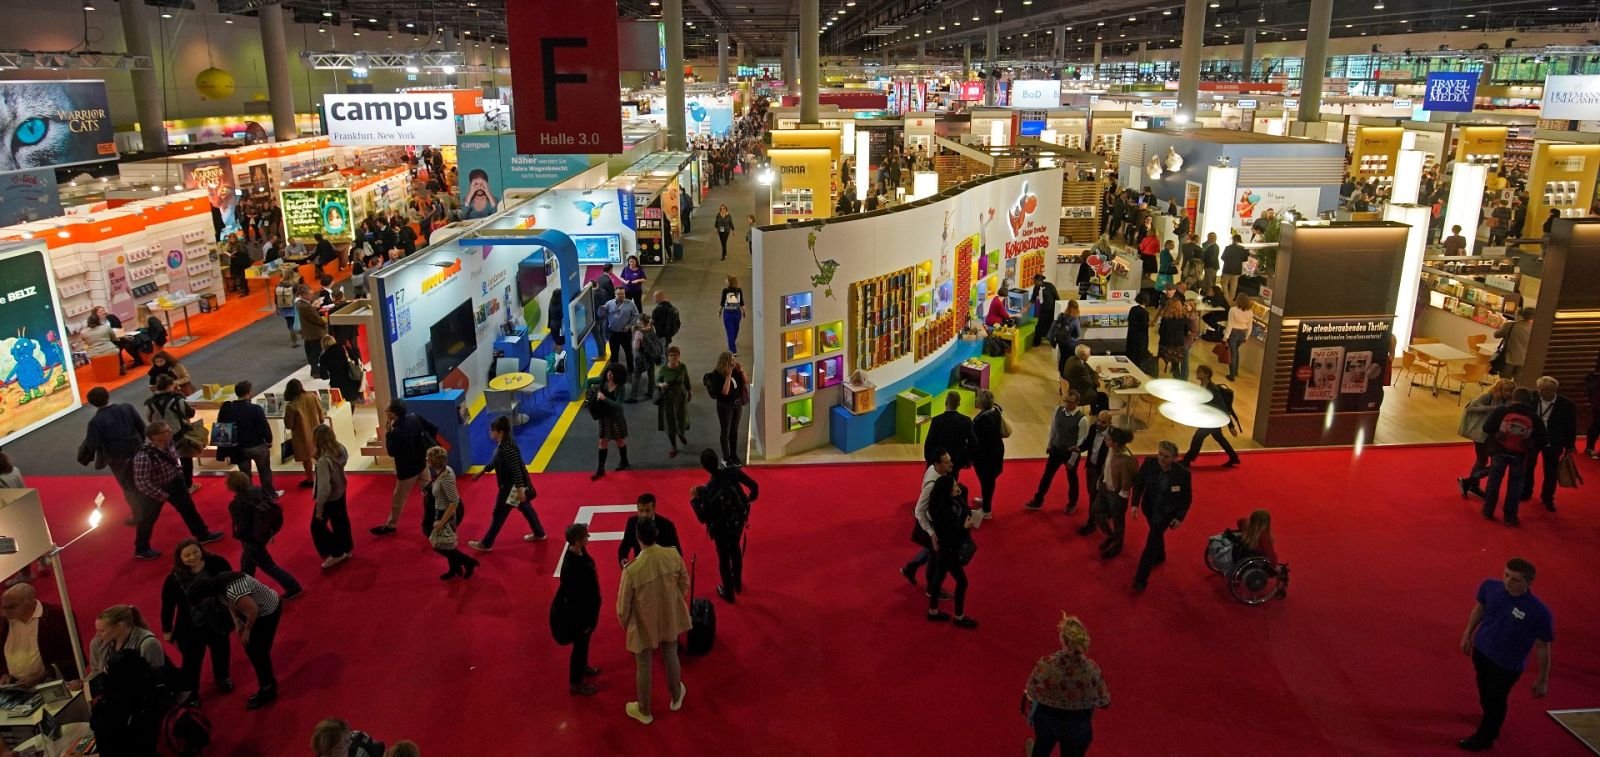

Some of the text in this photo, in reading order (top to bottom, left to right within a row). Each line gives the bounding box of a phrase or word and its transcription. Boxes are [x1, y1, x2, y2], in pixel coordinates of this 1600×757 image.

[540, 37, 588, 121] F
[1431, 79, 1469, 88] TRAVEL
[1431, 86, 1470, 95] HOUSE
[1429, 93, 1468, 102] MEDIA
[57, 109, 106, 120] WARRIOR
[331, 101, 448, 126] campus
[70, 119, 100, 133] CATS
[398, 131, 416, 139] York
[540, 133, 600, 145] Halle 3.0
[511, 157, 537, 165] Näher
[780, 165, 806, 174] DIANA
[7, 285, 38, 302] BELTZ
[395, 288, 405, 306] F7
[1302, 321, 1389, 333] Die atemberaubenden Thriller
